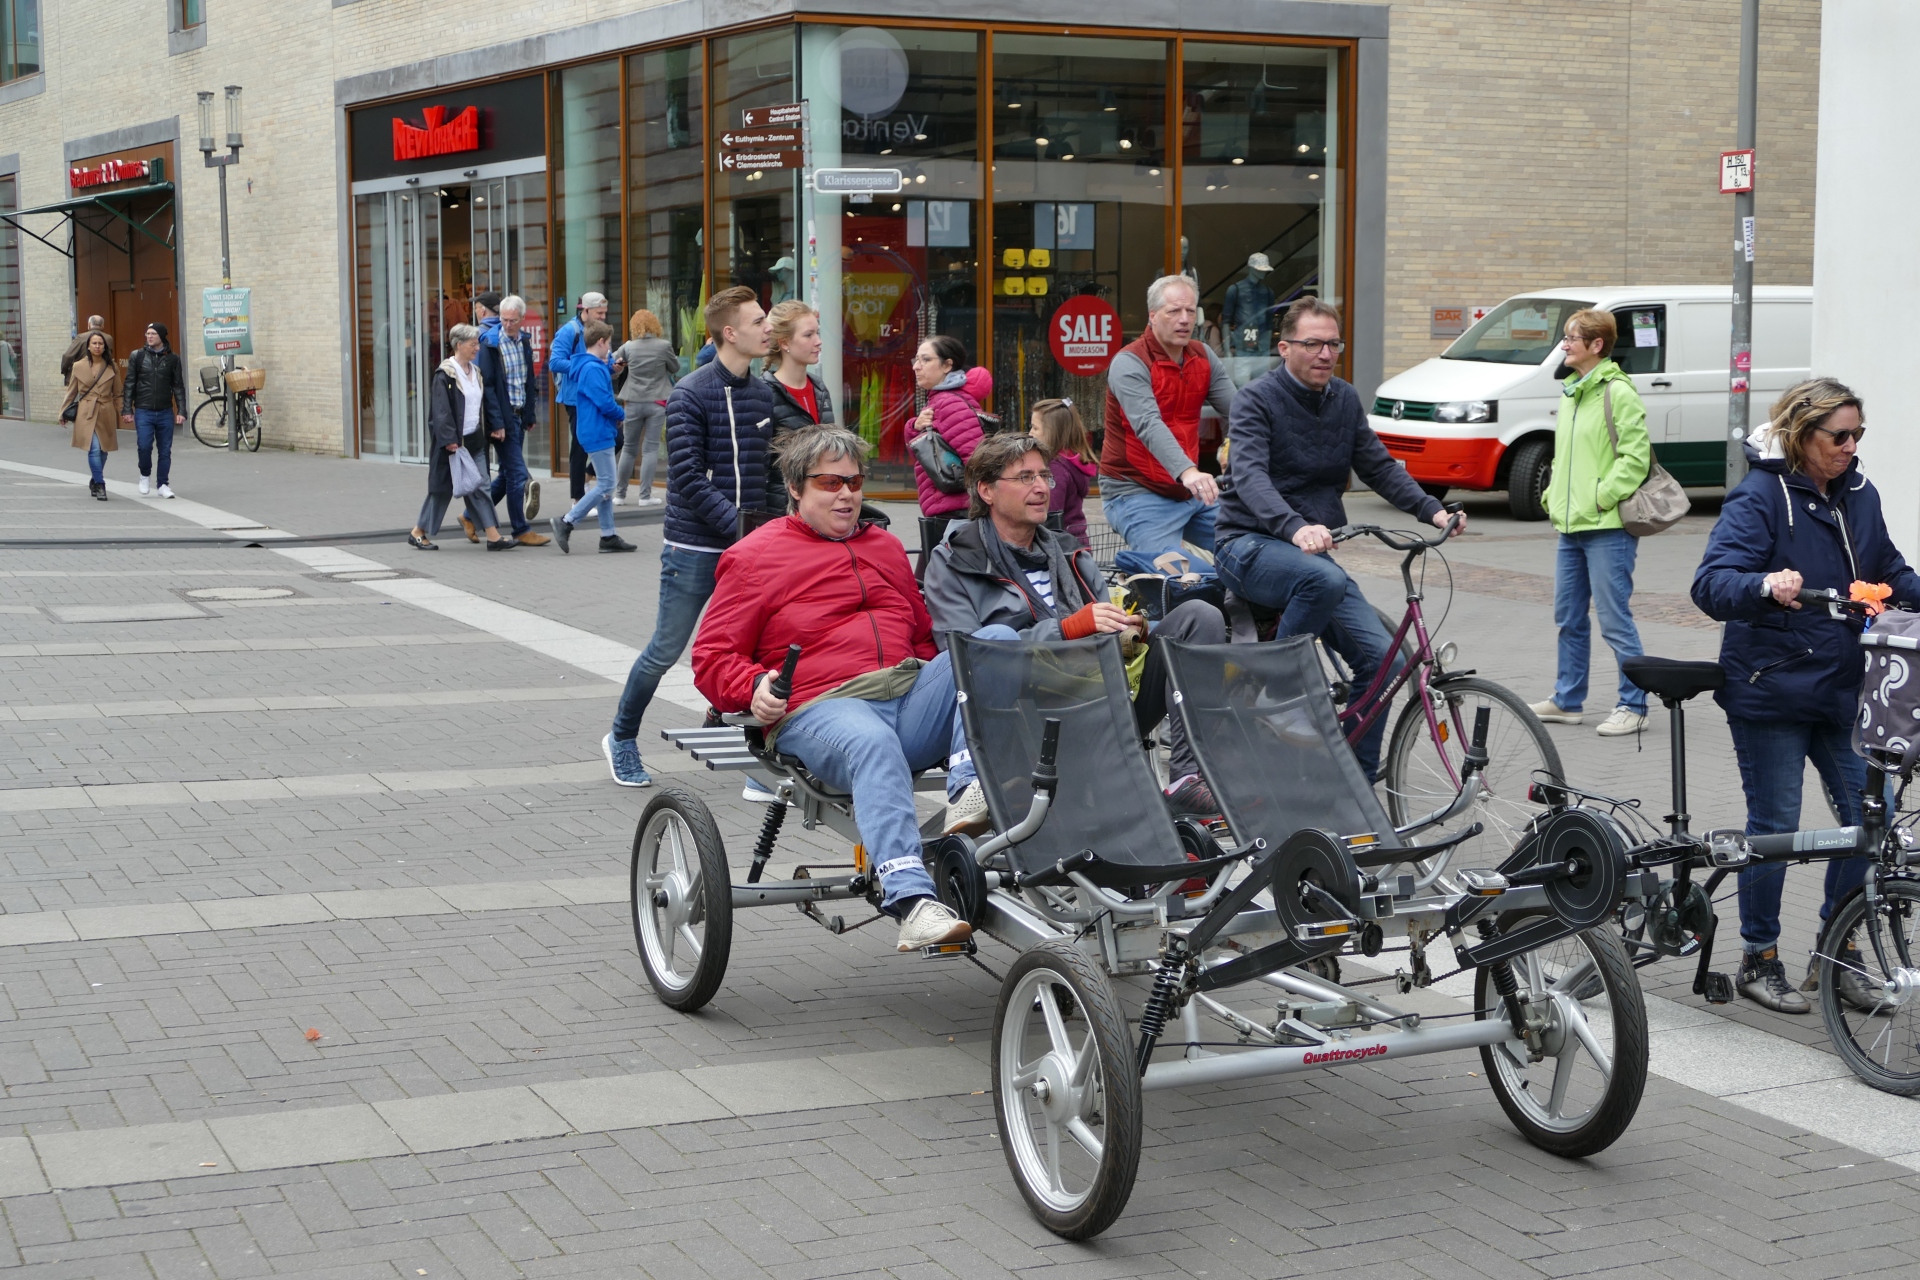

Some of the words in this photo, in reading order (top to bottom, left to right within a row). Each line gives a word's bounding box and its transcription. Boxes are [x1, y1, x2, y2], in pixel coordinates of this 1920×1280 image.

[769, 106, 800, 115] Hauptbahnhof
[735, 135, 764, 143] Euthymia
[735, 153, 780, 161] Erbdrostenhof
[1727, 156, 1732, 165] H
[736, 161, 783, 169] Clemenskirche
[824, 175, 892, 188] Klarissengasse
[1435, 310, 1462, 321] DAK
[1059, 314, 1113, 342] SALE
[1068, 346, 1104, 354] MIDSEASON
[1818, 838, 1852, 846] DAHON
[1303, 1043, 1388, 1064] Quattrocycle
